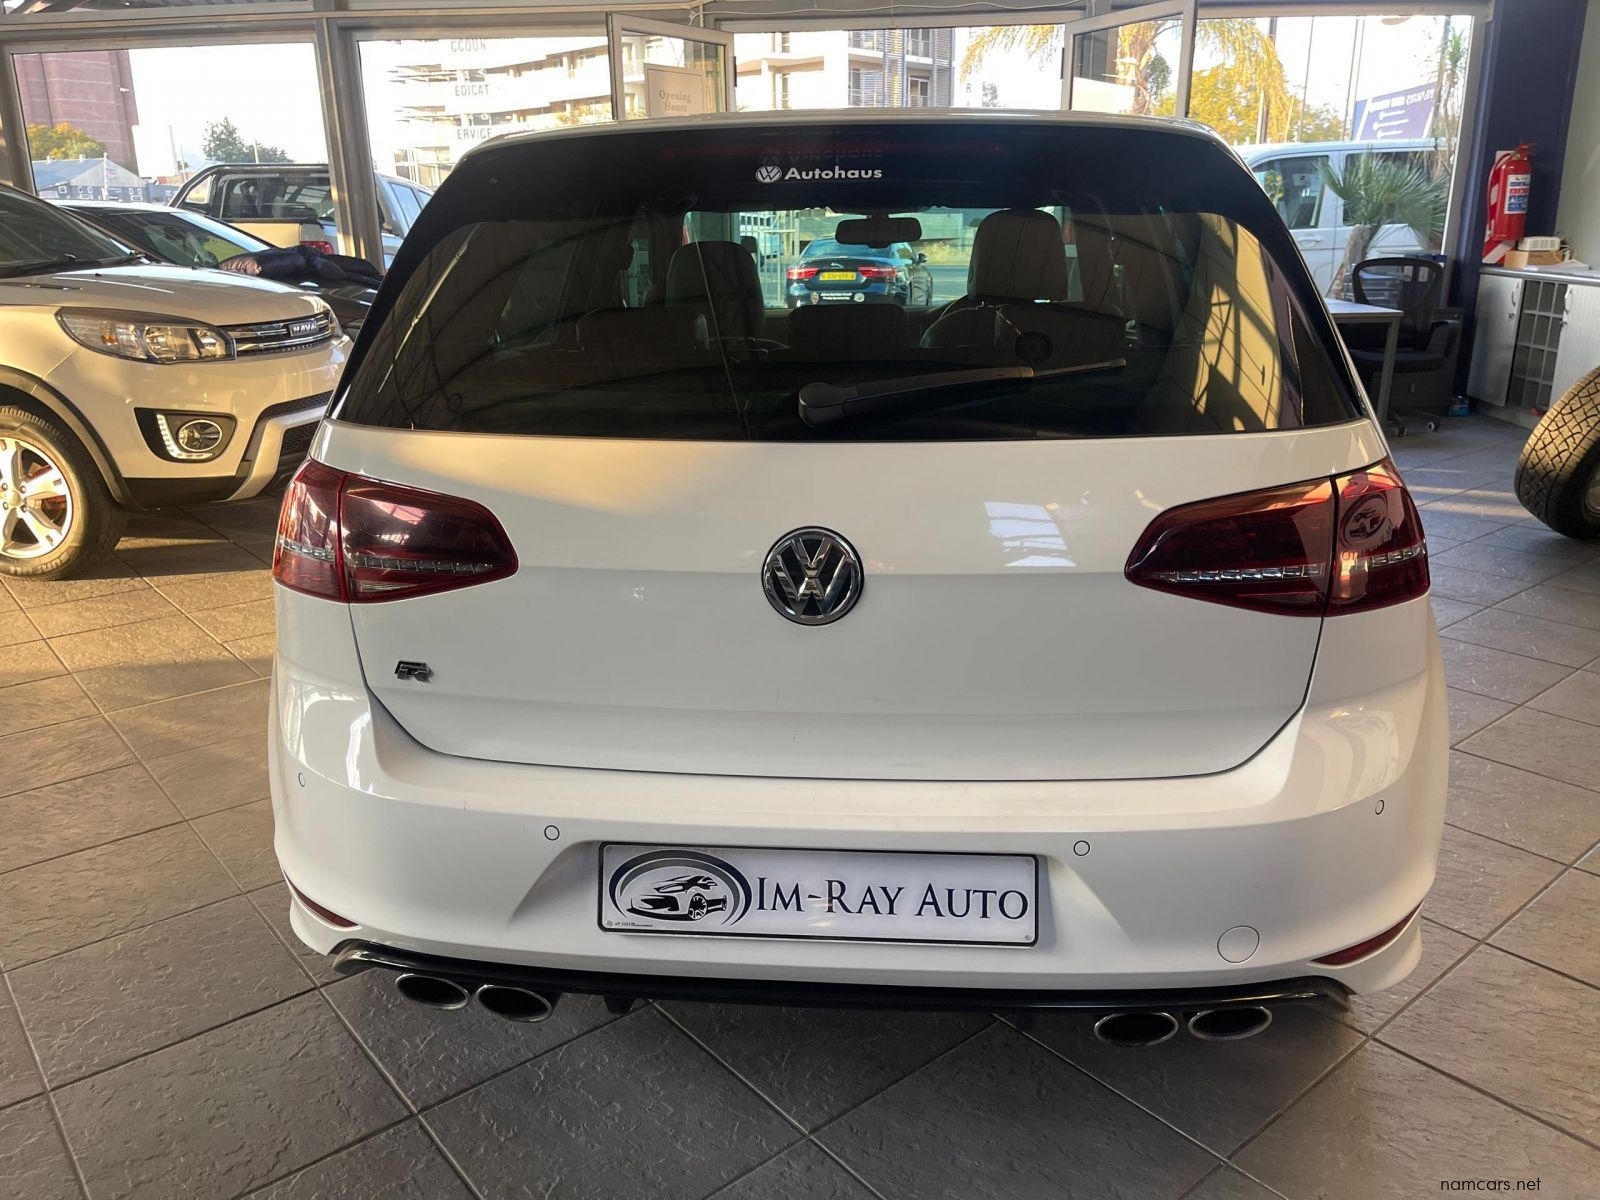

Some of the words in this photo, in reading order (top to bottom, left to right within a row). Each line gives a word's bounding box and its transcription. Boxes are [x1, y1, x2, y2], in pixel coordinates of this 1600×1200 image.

[659, 89, 692, 104] Opening
[664, 101, 687, 112] Hours
[784, 165, 883, 180] Autohaus
